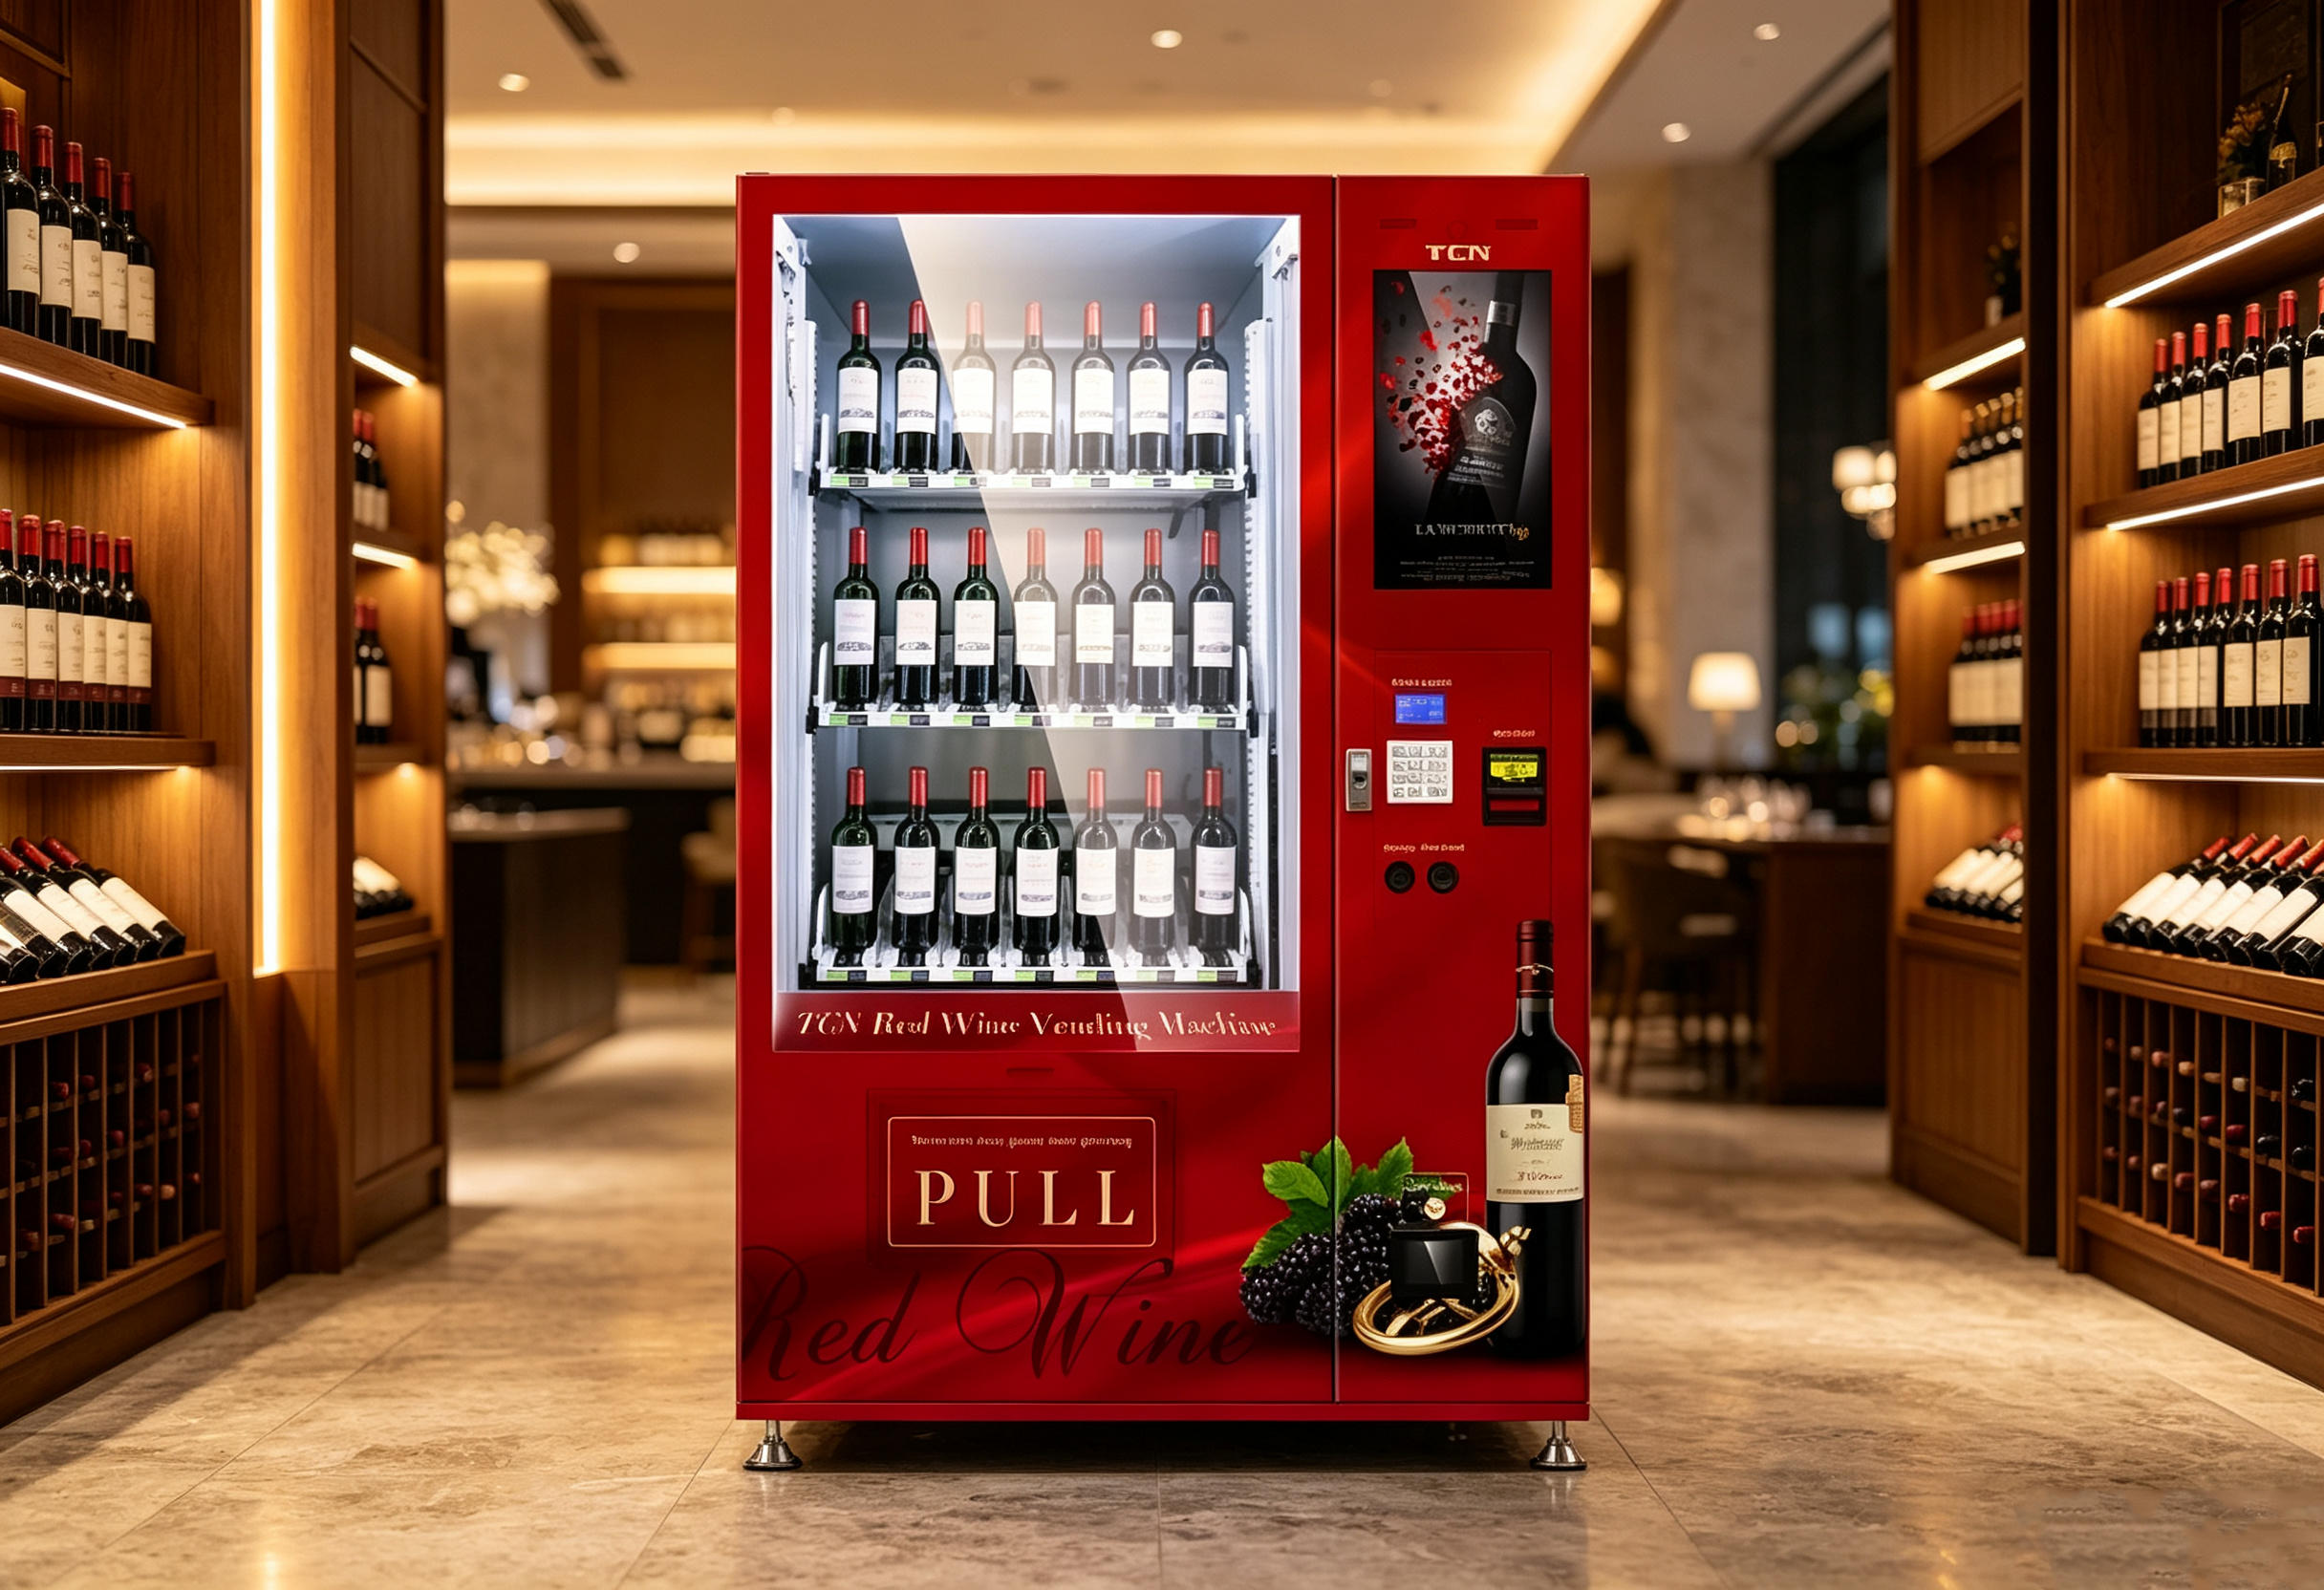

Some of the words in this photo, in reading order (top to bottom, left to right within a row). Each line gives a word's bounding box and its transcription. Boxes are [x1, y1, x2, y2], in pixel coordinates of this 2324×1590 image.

[1425, 244, 1492, 262] TCN
[872, 1010, 931, 1036] Red
[914, 1170, 1135, 1228] PULL
[741, 1245, 921, 1382] Red
[956, 1248, 1255, 1379] Wine
